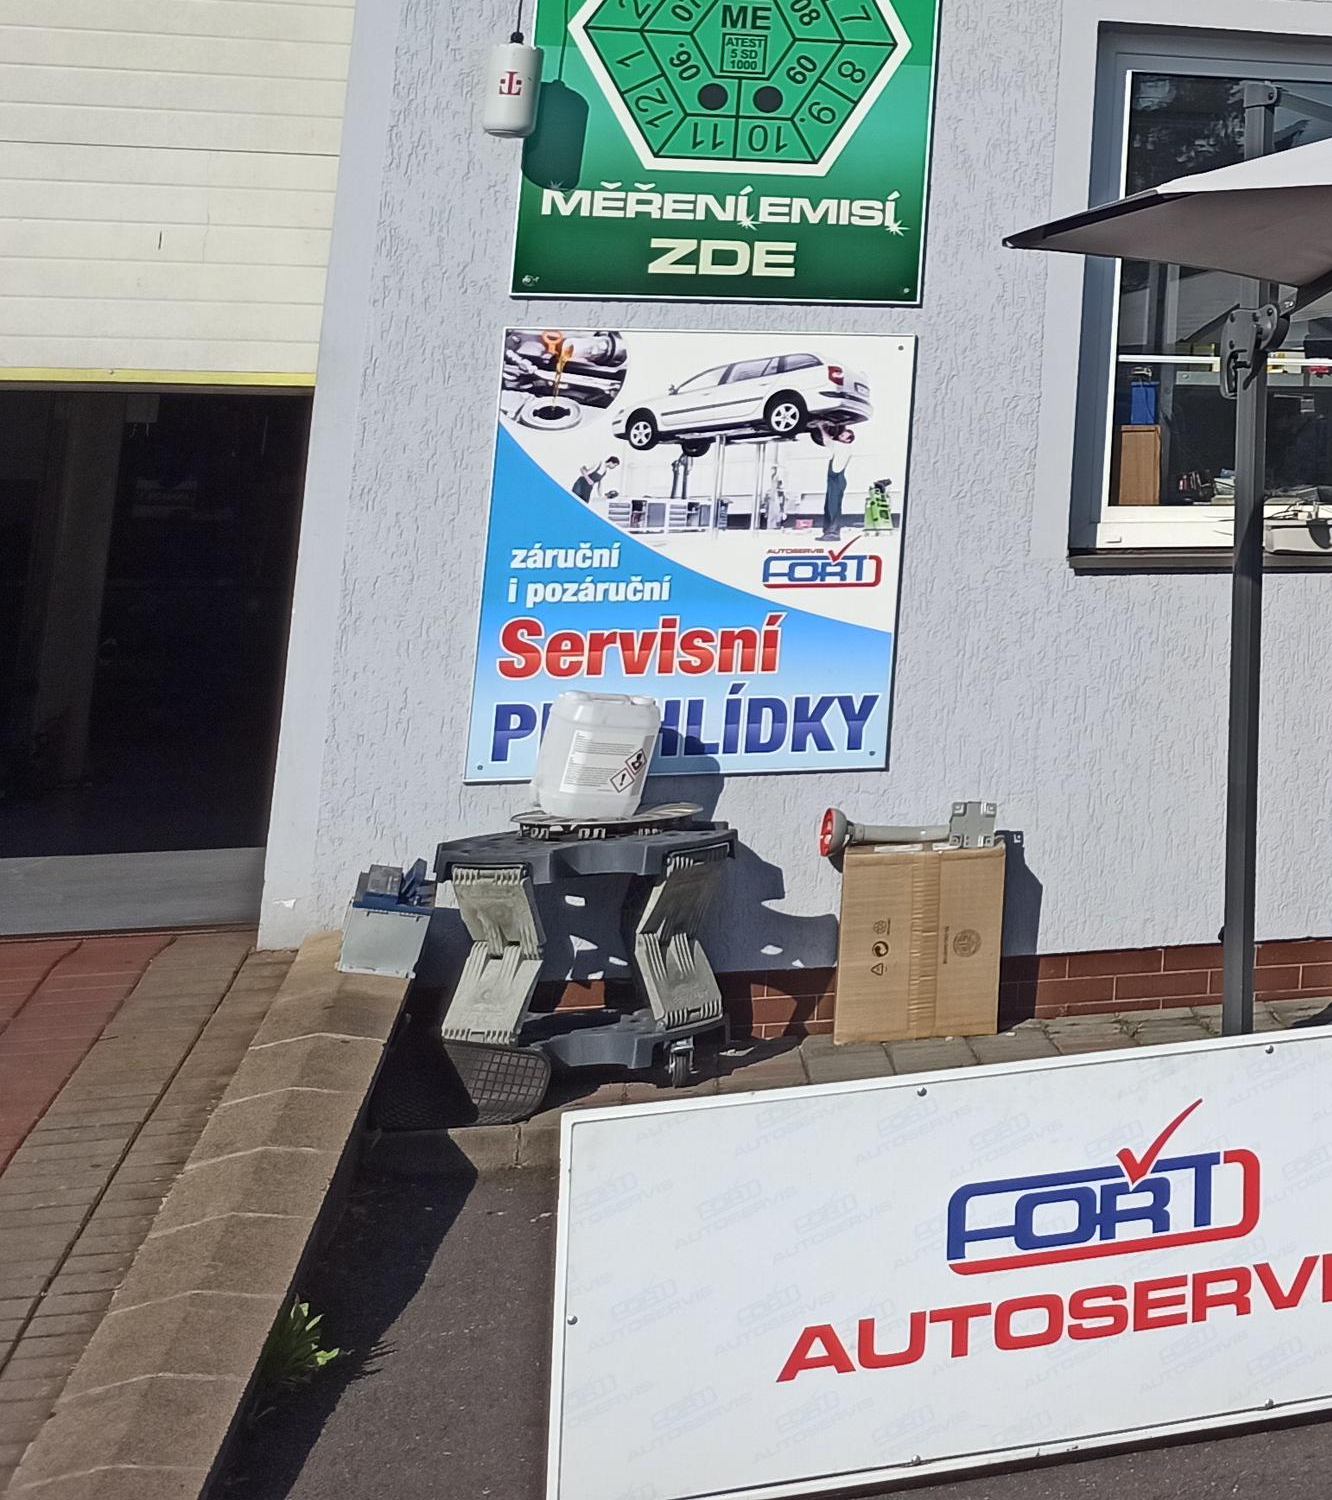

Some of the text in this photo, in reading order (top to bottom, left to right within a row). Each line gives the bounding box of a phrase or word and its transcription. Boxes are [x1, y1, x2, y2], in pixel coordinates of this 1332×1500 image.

[721, 4, 772, 31] ME
[840, 4, 873, 24] 7
[726, 37, 766, 48] ATEST
[615, 49, 645, 68] 1
[730, 60, 758, 70] 1000
[785, 54, 818, 85] 09
[837, 59, 867, 84] 8
[634, 87, 674, 128] 12
[691, 122, 725, 150] 11
[748, 124, 788, 154] 10
[541, 181, 903, 230] MĚŘENÍ EMISÍ
[648, 238, 798, 278] ZDE
[509, 540, 622, 569] záruční
[762, 555, 883, 588] FORT
[507, 575, 673, 608] i pozáruční
[496, 611, 788, 681] Servisní
[947, 1148, 1260, 1276] FORT
